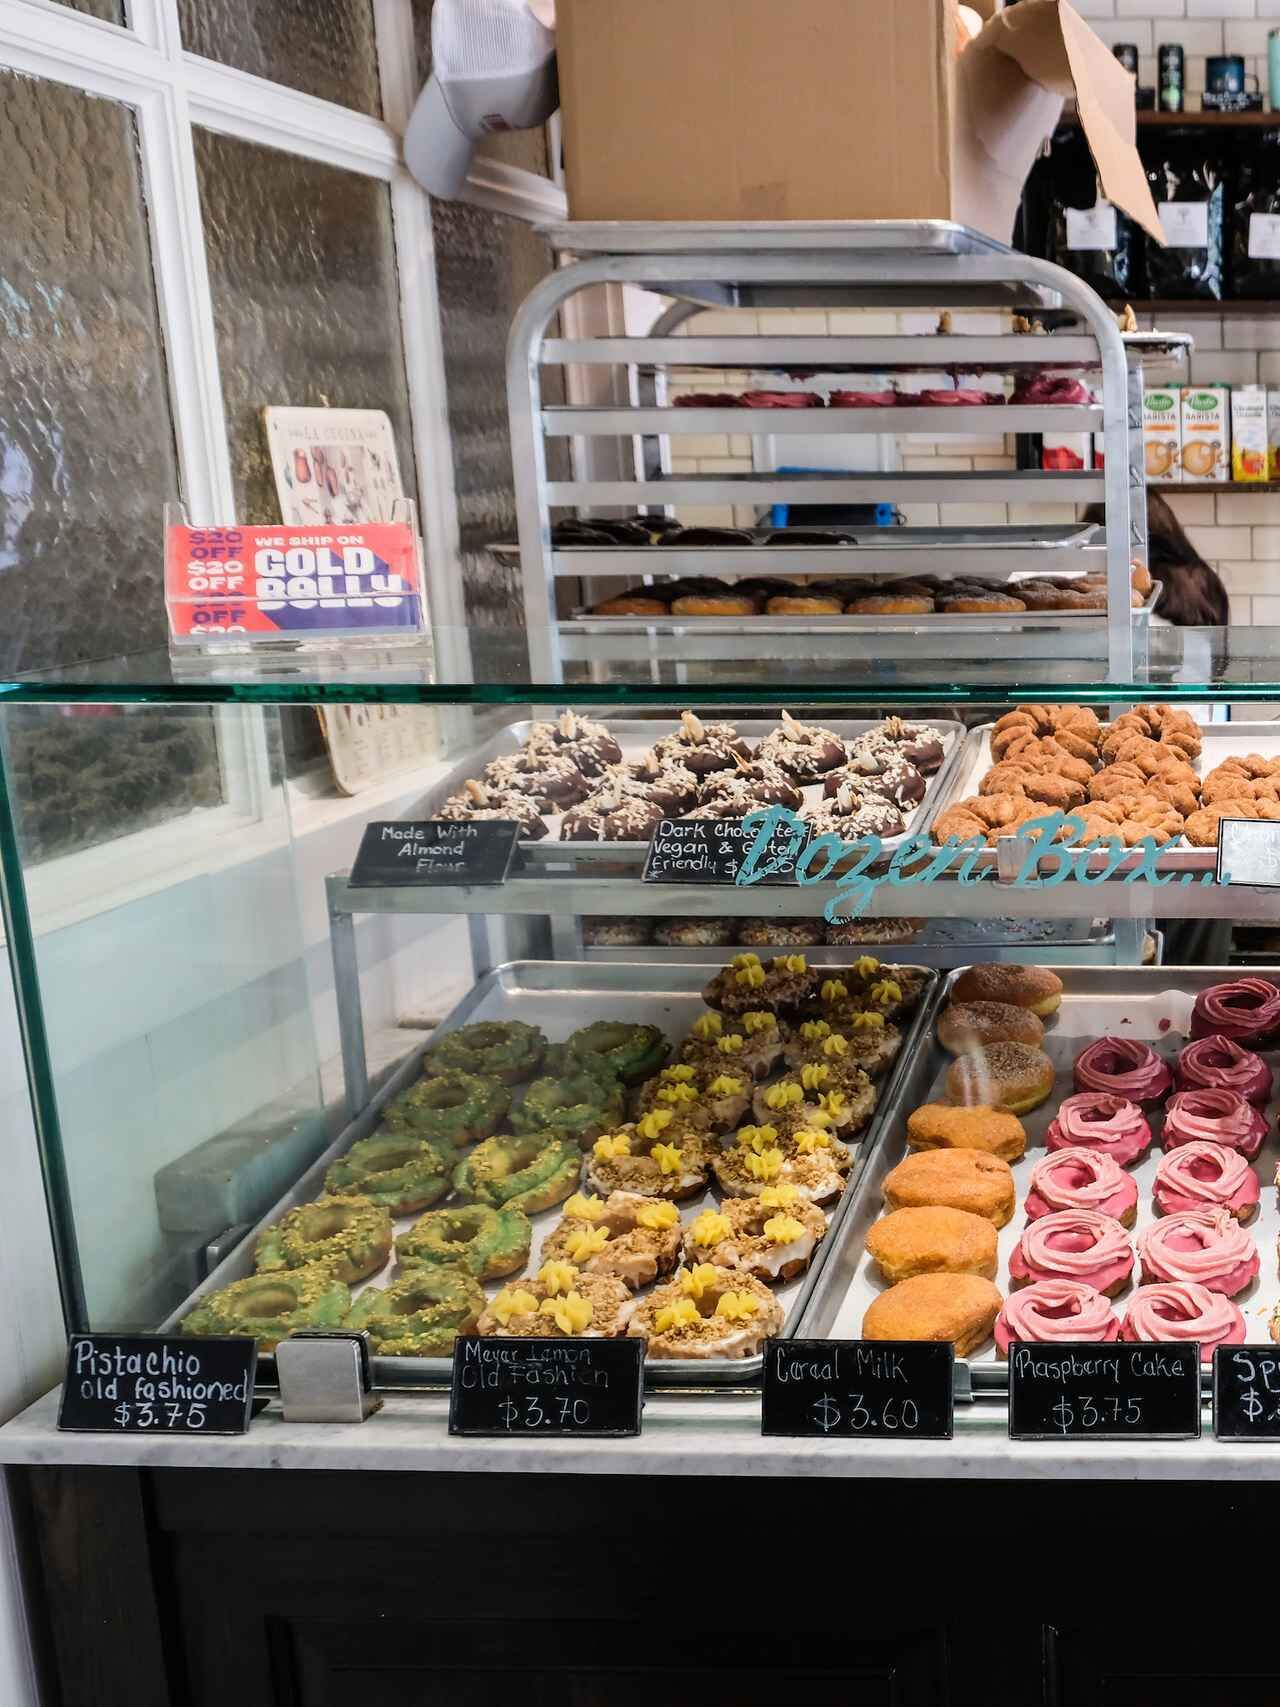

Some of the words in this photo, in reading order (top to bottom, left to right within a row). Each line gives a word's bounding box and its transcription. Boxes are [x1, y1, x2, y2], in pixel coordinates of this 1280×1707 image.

[189, 531, 243, 544] $20
[255, 536, 286, 546] WE
[289, 536, 333, 546] SHIP
[337, 535, 365, 545] ON
[191, 547, 243, 559] OFF
[254, 547, 374, 578] GOLD
[188, 560, 244, 576] $20
[188, 576, 244, 591] OFF
[192, 610, 246, 624] OFF
[381, 826, 425, 840] Made
[437, 825, 478, 840] With
[660, 821, 705, 837] Dark
[714, 821, 793, 838] Chocote
[398, 841, 465, 856] Almond
[654, 841, 708, 855] Vegan
[719, 842, 733, 854] &
[736, 804, 993, 924] Dozen
[74, 1339, 201, 1377] Pistachio
[856, 1348, 909, 1383] Milk
[1015, 1349, 1120, 1384] Raspberry
[1130, 1352, 1185, 1377] Cake
[461, 1364, 499, 1389] Old
[113, 1401, 208, 1429] $3.75
[498, 1395, 591, 1429] $3.70
[813, 1392, 919, 1431] $3.60
[1052, 1395, 1144, 1434] $3.75
